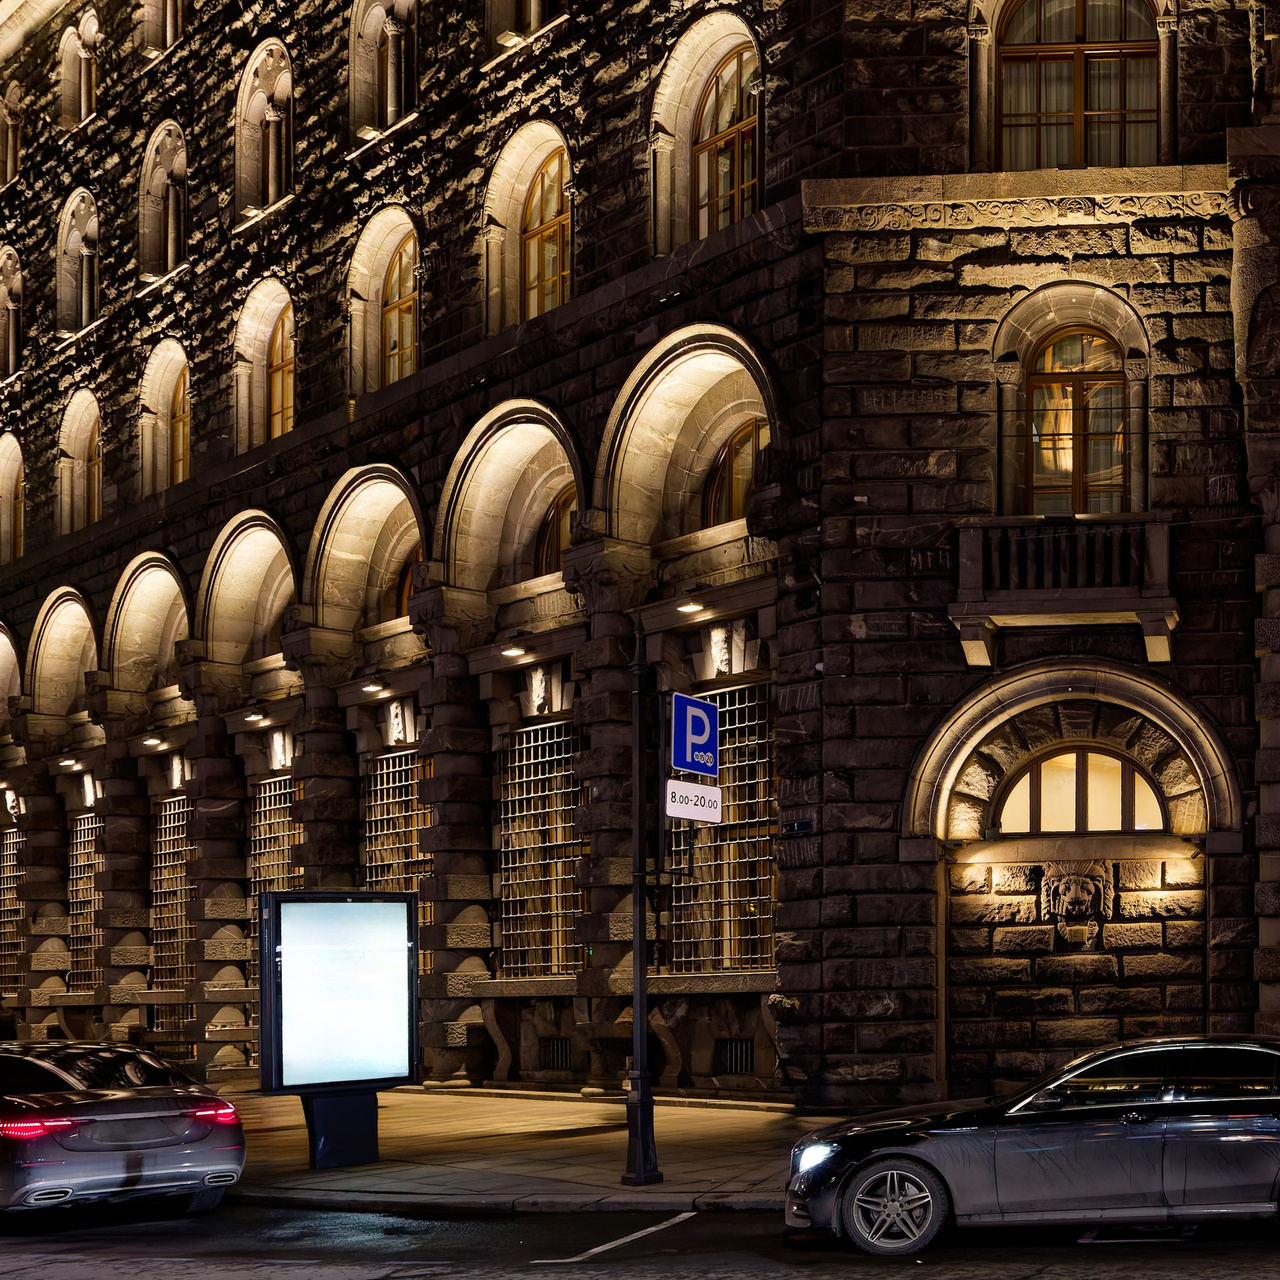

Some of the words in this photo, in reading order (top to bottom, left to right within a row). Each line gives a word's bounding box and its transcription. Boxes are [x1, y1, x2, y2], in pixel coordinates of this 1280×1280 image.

[686, 705, 711, 763] P
[706, 754, 713, 765] 20
[670, 791, 718, 809] 8.00-20.00
